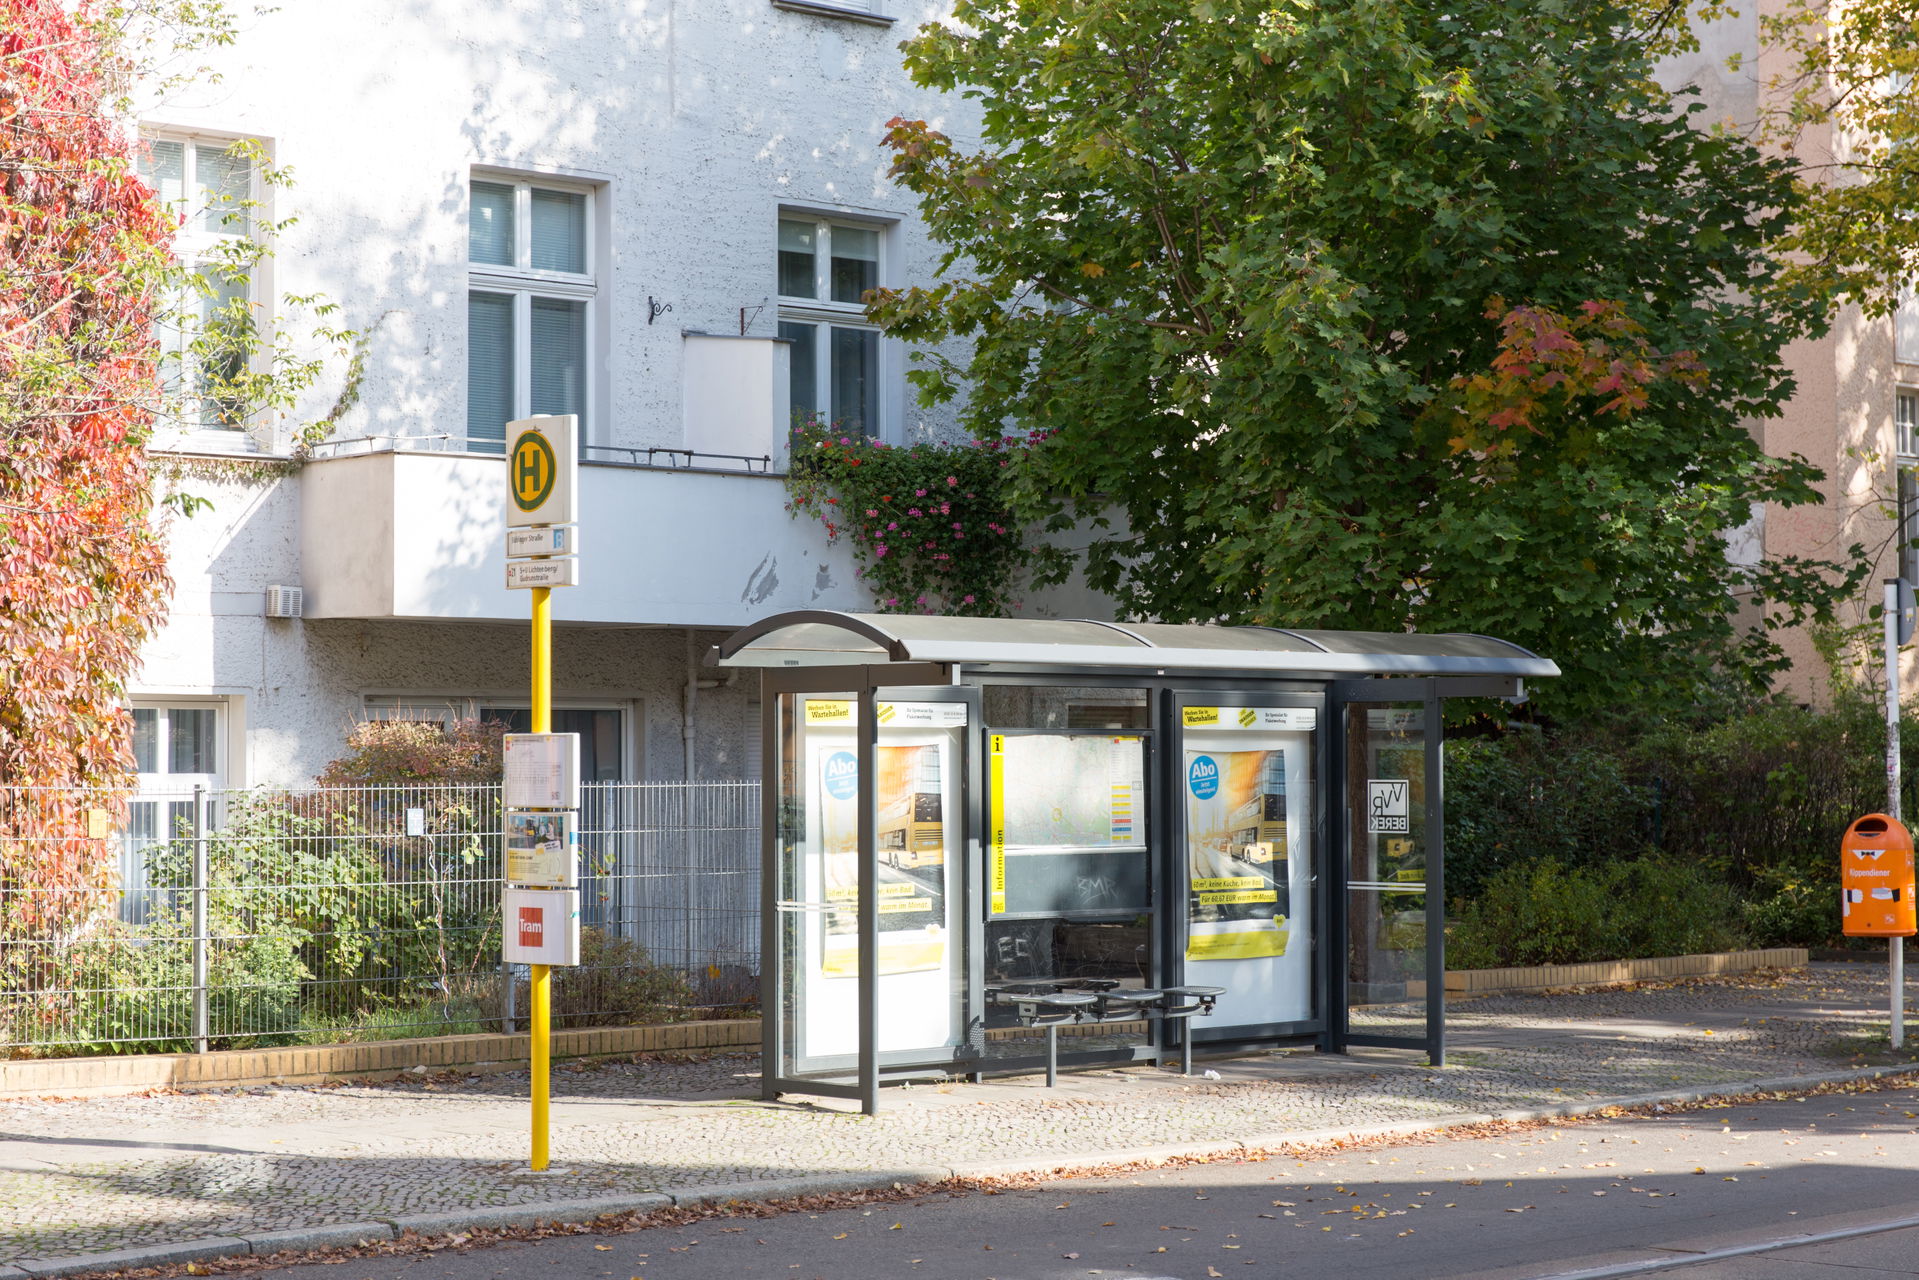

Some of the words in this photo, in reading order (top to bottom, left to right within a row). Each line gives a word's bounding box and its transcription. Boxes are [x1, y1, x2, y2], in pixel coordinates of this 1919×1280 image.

[519, 449, 541, 493] H
[811, 709, 848, 718] Wartehallen!
[1187, 714, 1218, 723] Wartehallen!
[994, 737, 1000, 752] i
[829, 758, 857, 777] Abo
[1192, 761, 1215, 778] Abo
[996, 830, 1004, 889] Information
[1849, 868, 1891, 878] Kippendiener
[1202, 895, 1210, 903] Für
[1226, 894, 1237, 902] EUR
[520, 918, 542, 933] Tram
